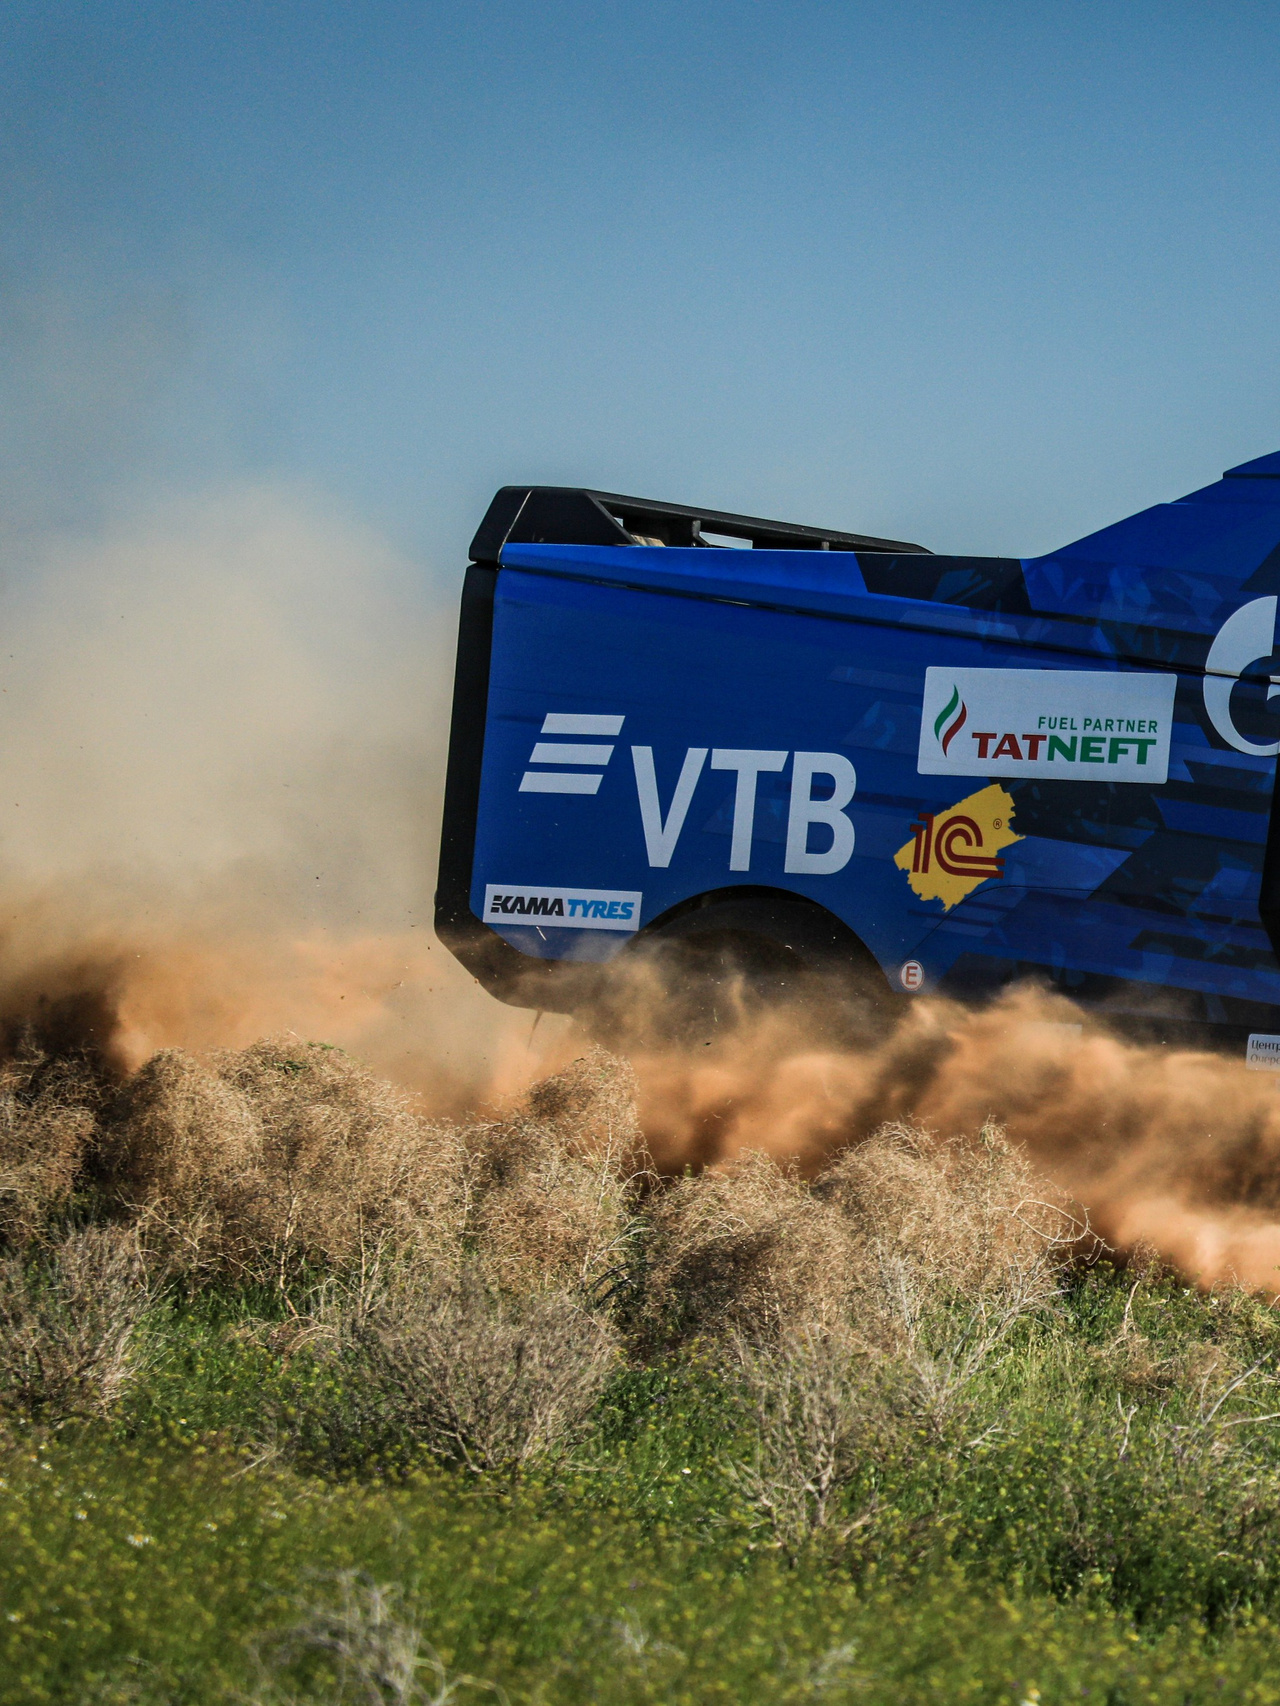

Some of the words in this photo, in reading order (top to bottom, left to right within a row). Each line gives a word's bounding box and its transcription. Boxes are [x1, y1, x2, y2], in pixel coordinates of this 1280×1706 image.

[1038, 716, 1078, 730] FUEL
[1083, 718, 1158, 733] PARTNER
[972, 732, 1158, 765] TATNEFT
[630, 745, 858, 876] VTB
[490, 895, 565, 917] KAMA
[567, 899, 635, 921] TYRES
[905, 966, 918, 985] E
